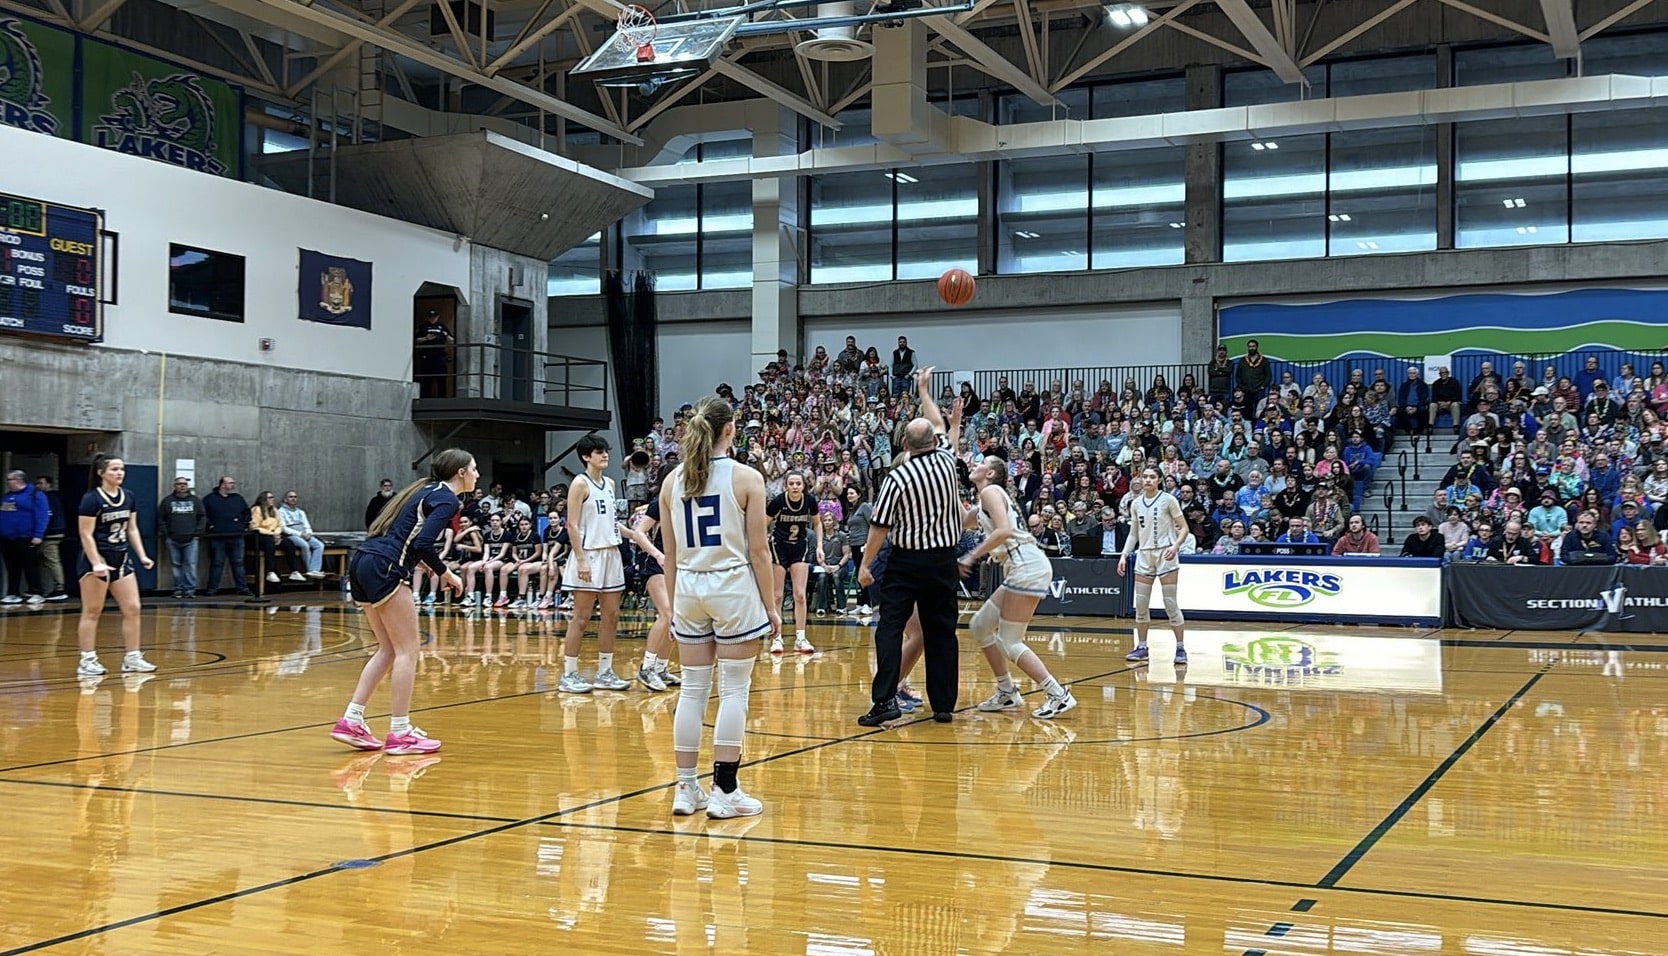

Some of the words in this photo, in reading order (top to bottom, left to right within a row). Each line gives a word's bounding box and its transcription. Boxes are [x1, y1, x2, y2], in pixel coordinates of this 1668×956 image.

[50, 238, 94, 256] GUEST
[11, 249, 45, 262] BONUS
[17, 264, 45, 277] POSS
[76, 258, 91, 284] 0
[19, 277, 45, 290] FOUL
[66, 284, 95, 297] FOULS
[75, 298, 90, 323] 0
[62, 324, 95, 336] SCORE
[595, 499, 606, 514] 15
[680, 494, 722, 548] 12
[788, 524, 799, 541] 2
[1224, 570, 1341, 592] LAKERS
[1065, 587, 1120, 595] ATHLETICS
[1258, 590, 1297, 601] FL
[1526, 599, 1598, 609] SECTION
